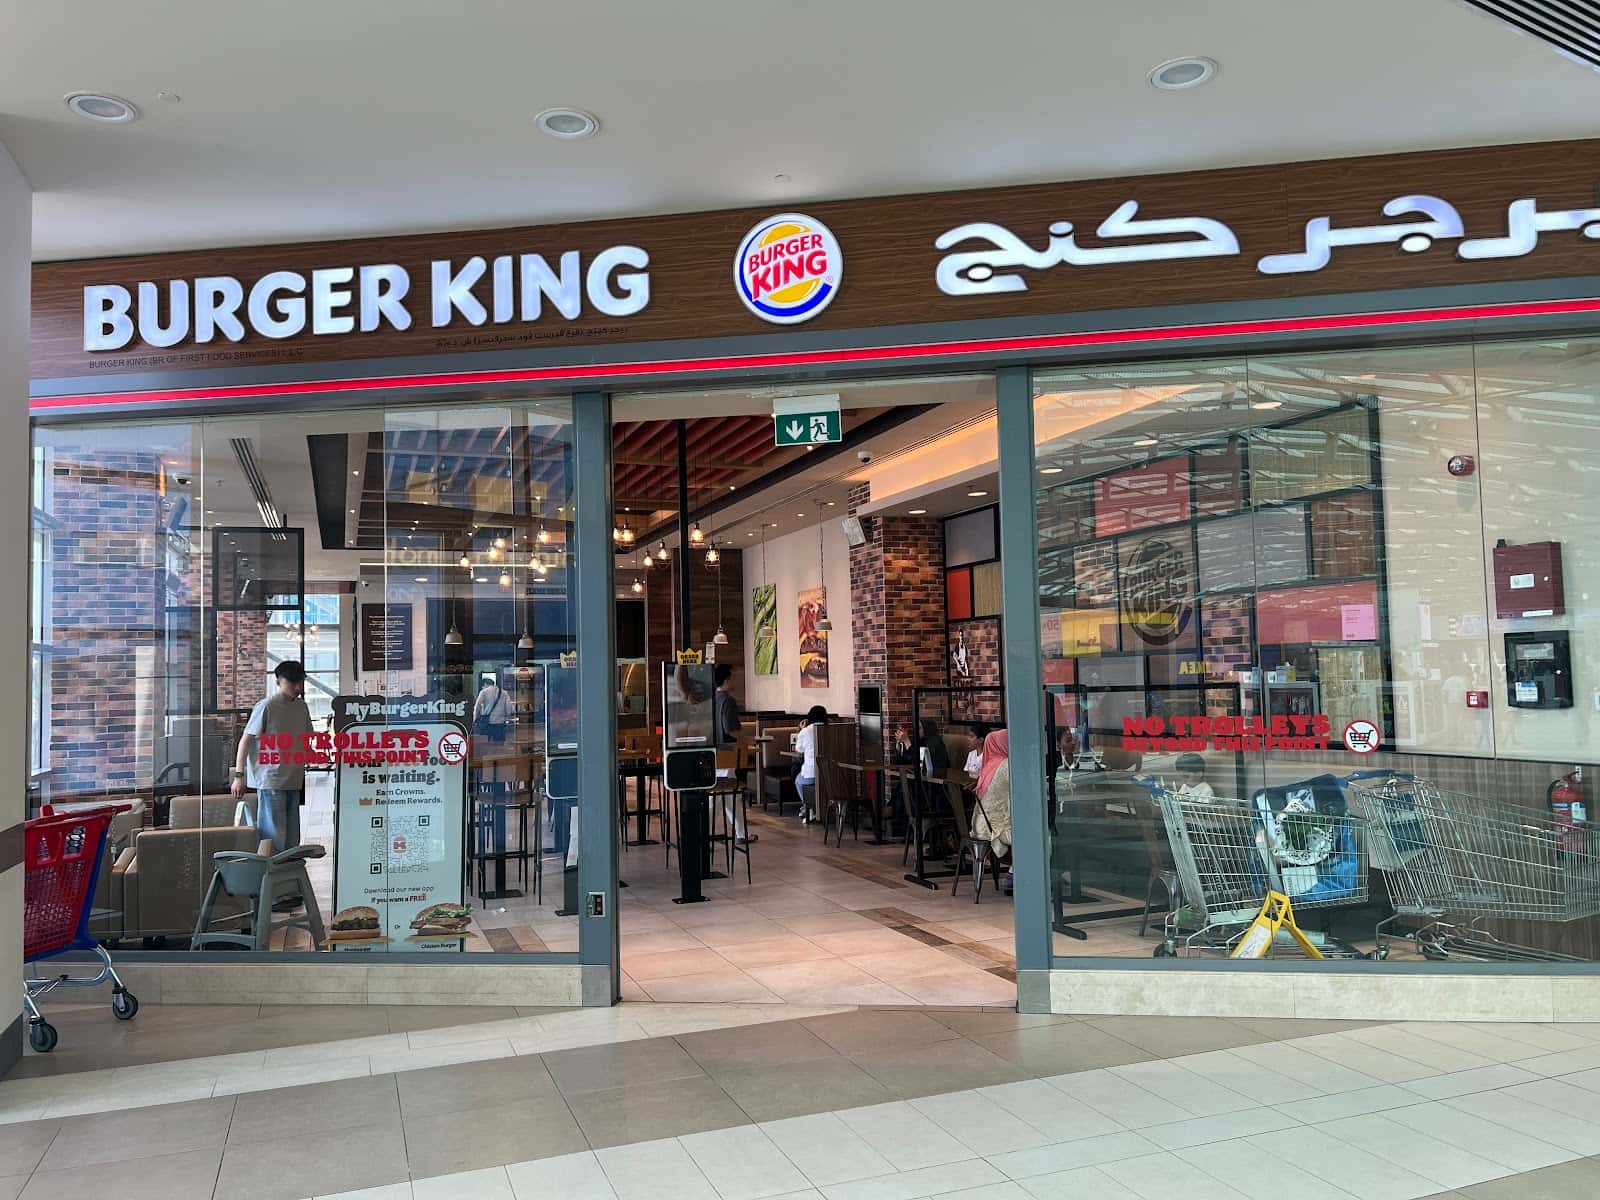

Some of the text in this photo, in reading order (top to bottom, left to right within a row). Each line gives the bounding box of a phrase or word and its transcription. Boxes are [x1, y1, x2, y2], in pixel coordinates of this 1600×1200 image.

[749, 234, 823, 273] BURGER
[935, 200, 1240, 295] كنج
[752, 250, 828, 300] KING
[83, 245, 651, 353] BURGER KING
[89, 360, 125, 369] BURGER
[127, 358, 147, 367] KING
[345, 699, 466, 721] MyBurgerKing
[1122, 714, 1331, 736] NO TROLLEYS
[259, 730, 430, 750] NO TROLLEYS
[1121, 735, 1331, 751] BEYOND THIS POINT
[258, 751, 327, 765] BEYOND
[334, 751, 372, 764] THIS
[375, 749, 430, 764] POINT
[423, 753, 453, 766] foo
[362, 769, 441, 785] is waiting.
[395, 788, 427, 796] Crowns.
[407, 796, 443, 804] Rewards.
